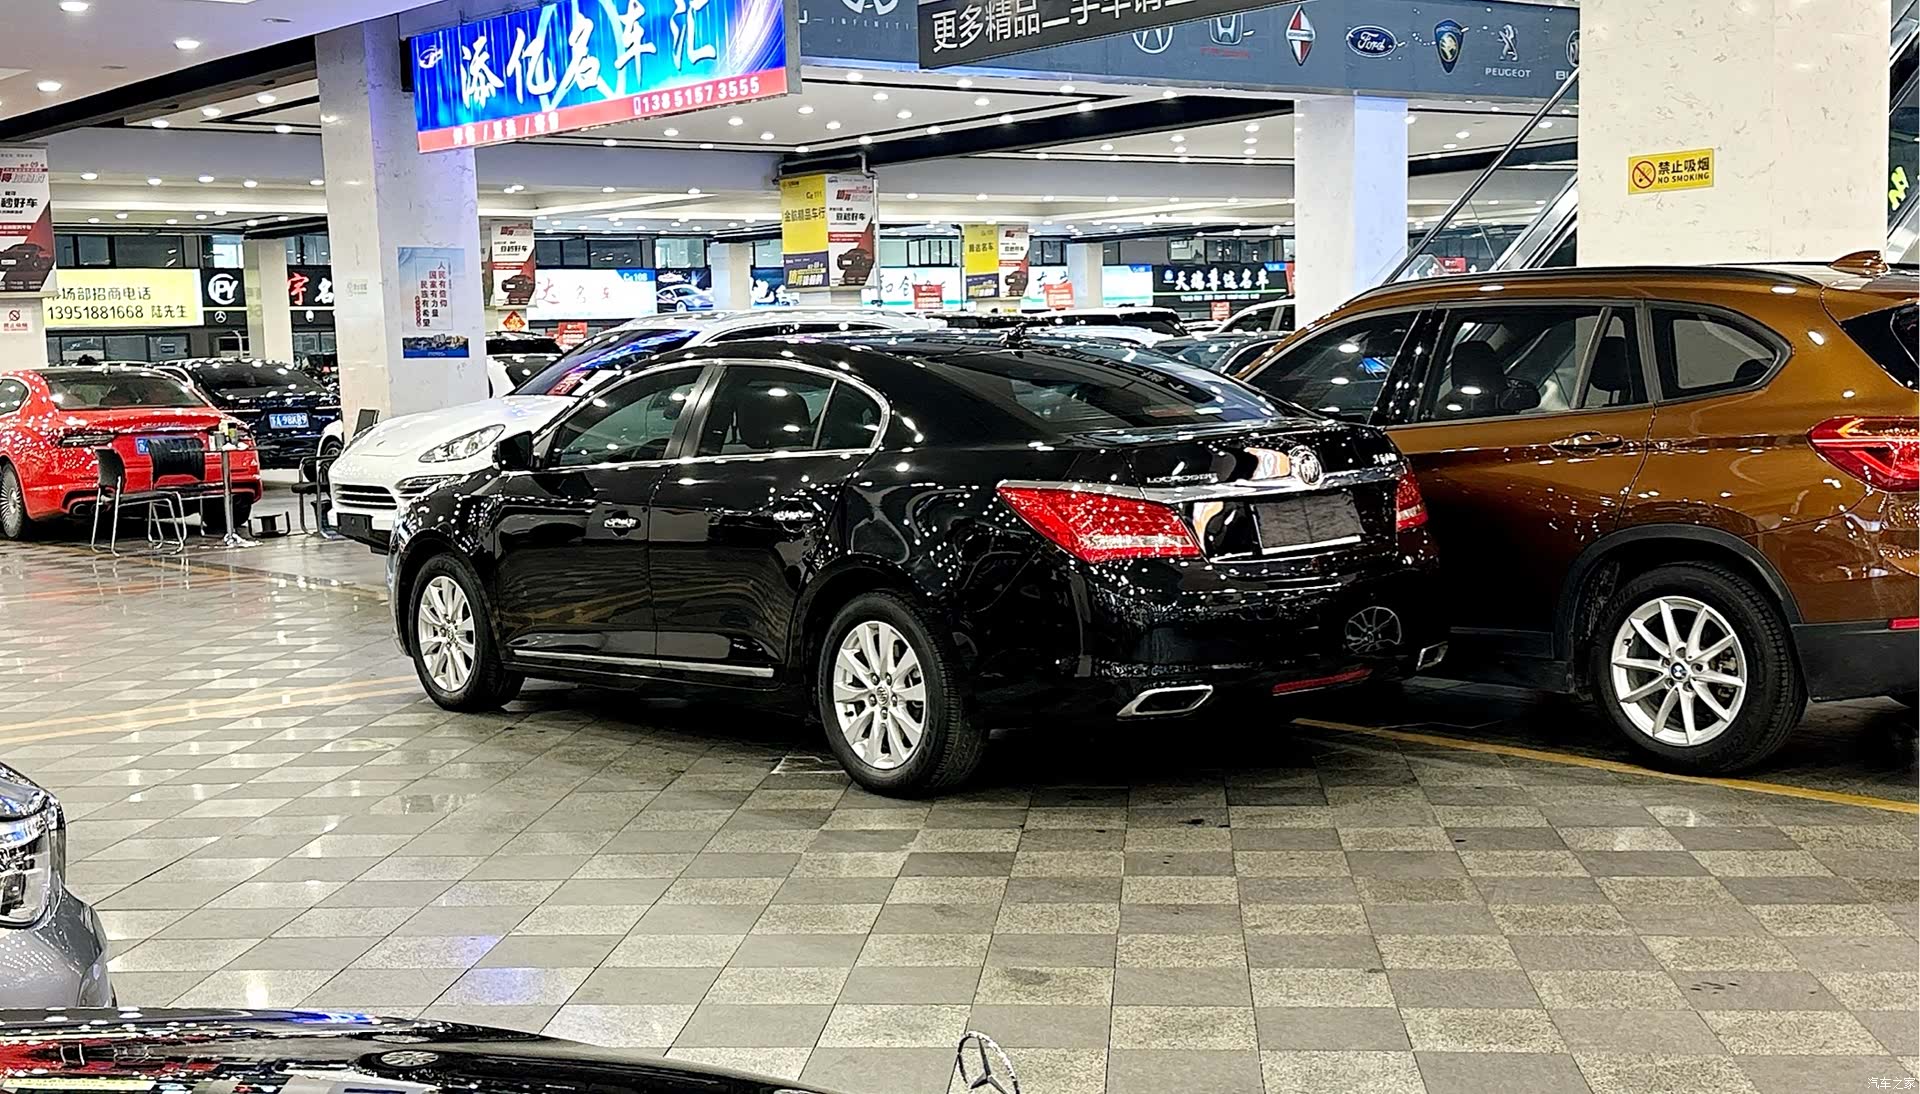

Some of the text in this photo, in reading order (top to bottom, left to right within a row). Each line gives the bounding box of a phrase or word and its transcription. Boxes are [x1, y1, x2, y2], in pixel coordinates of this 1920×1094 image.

[831, 16, 909, 30] INFINITI
[1358, 31, 1386, 51] Ford
[1485, 67, 1532, 78] PEUGEOT
[1658, 157, 1710, 176] 禁止吸烟
[1672, 172, 1710, 183] SMOKING
[438, 261, 448, 307] 人民有信仰
[429, 271, 439, 317] 国家有力量
[47, 305, 188, 320] 13951881668 陆先生
[420, 281, 430, 327] 民族有希望
